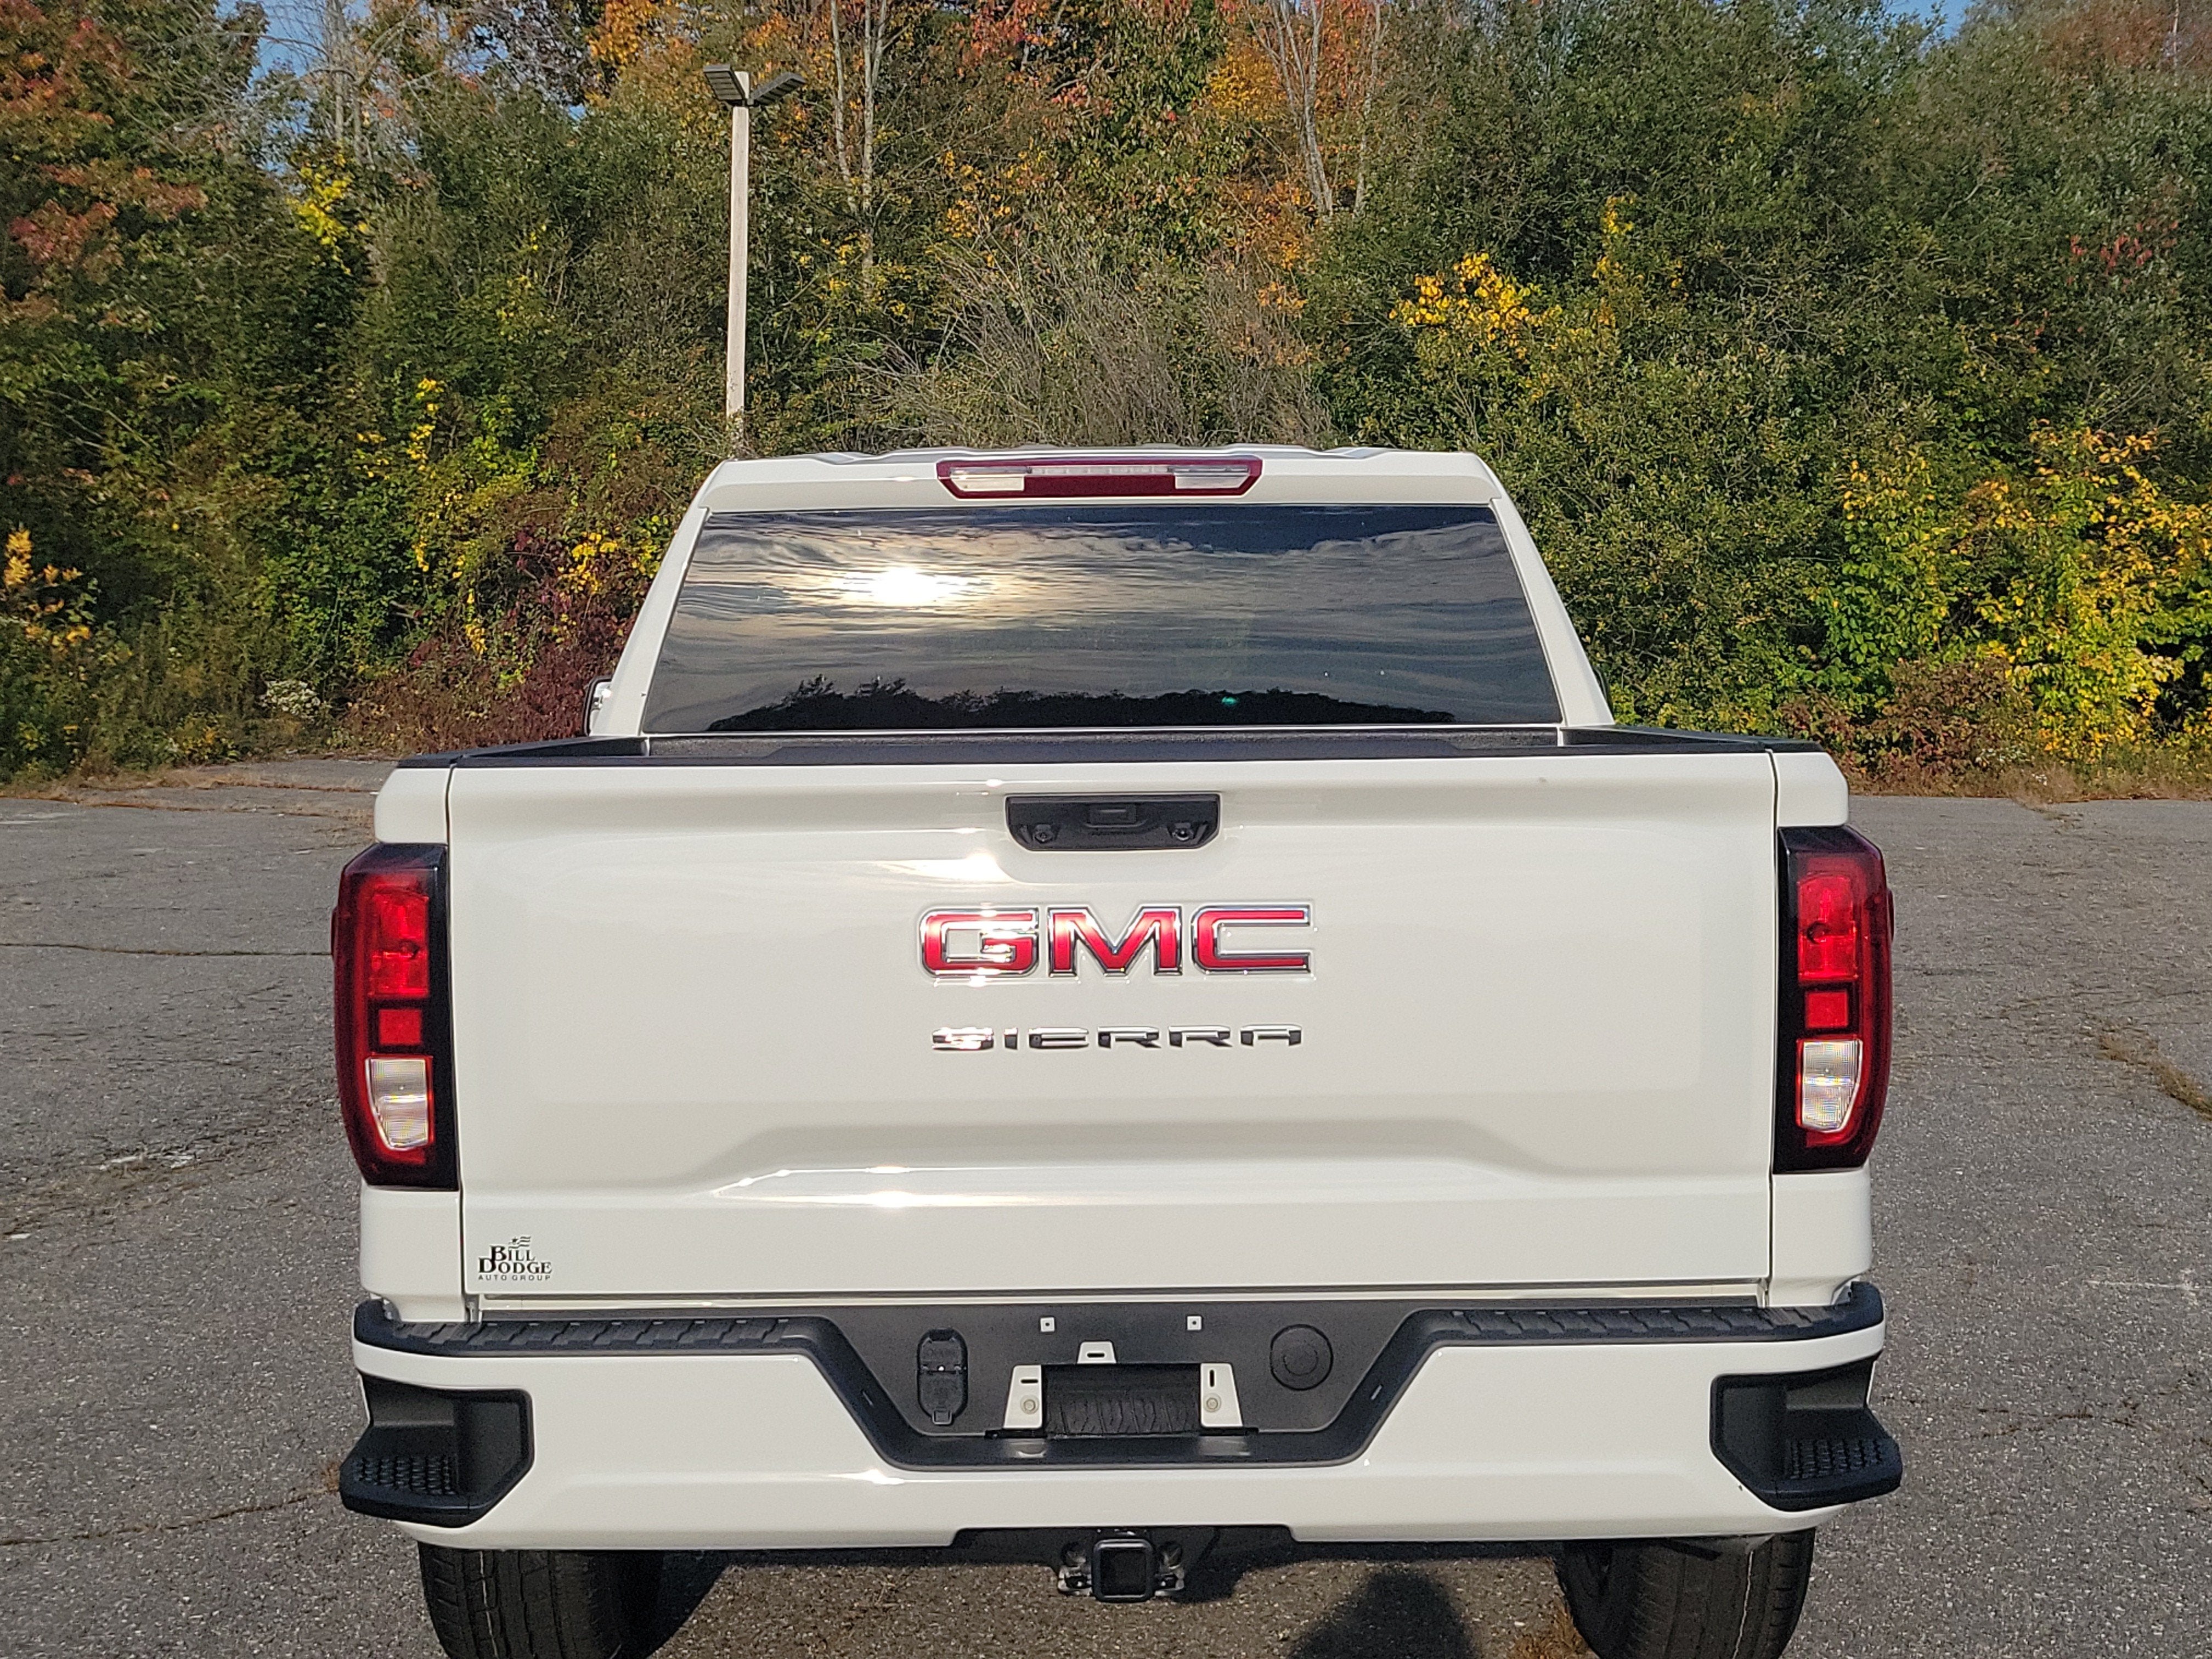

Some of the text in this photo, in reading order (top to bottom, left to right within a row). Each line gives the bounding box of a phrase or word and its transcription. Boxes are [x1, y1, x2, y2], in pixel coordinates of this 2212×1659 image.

[921, 905, 1311, 978] GMC
[932, 1024, 1303, 1050] SIERRA
[489, 1245, 535, 1261] BILL
[478, 1257, 552, 1273] DODGE
